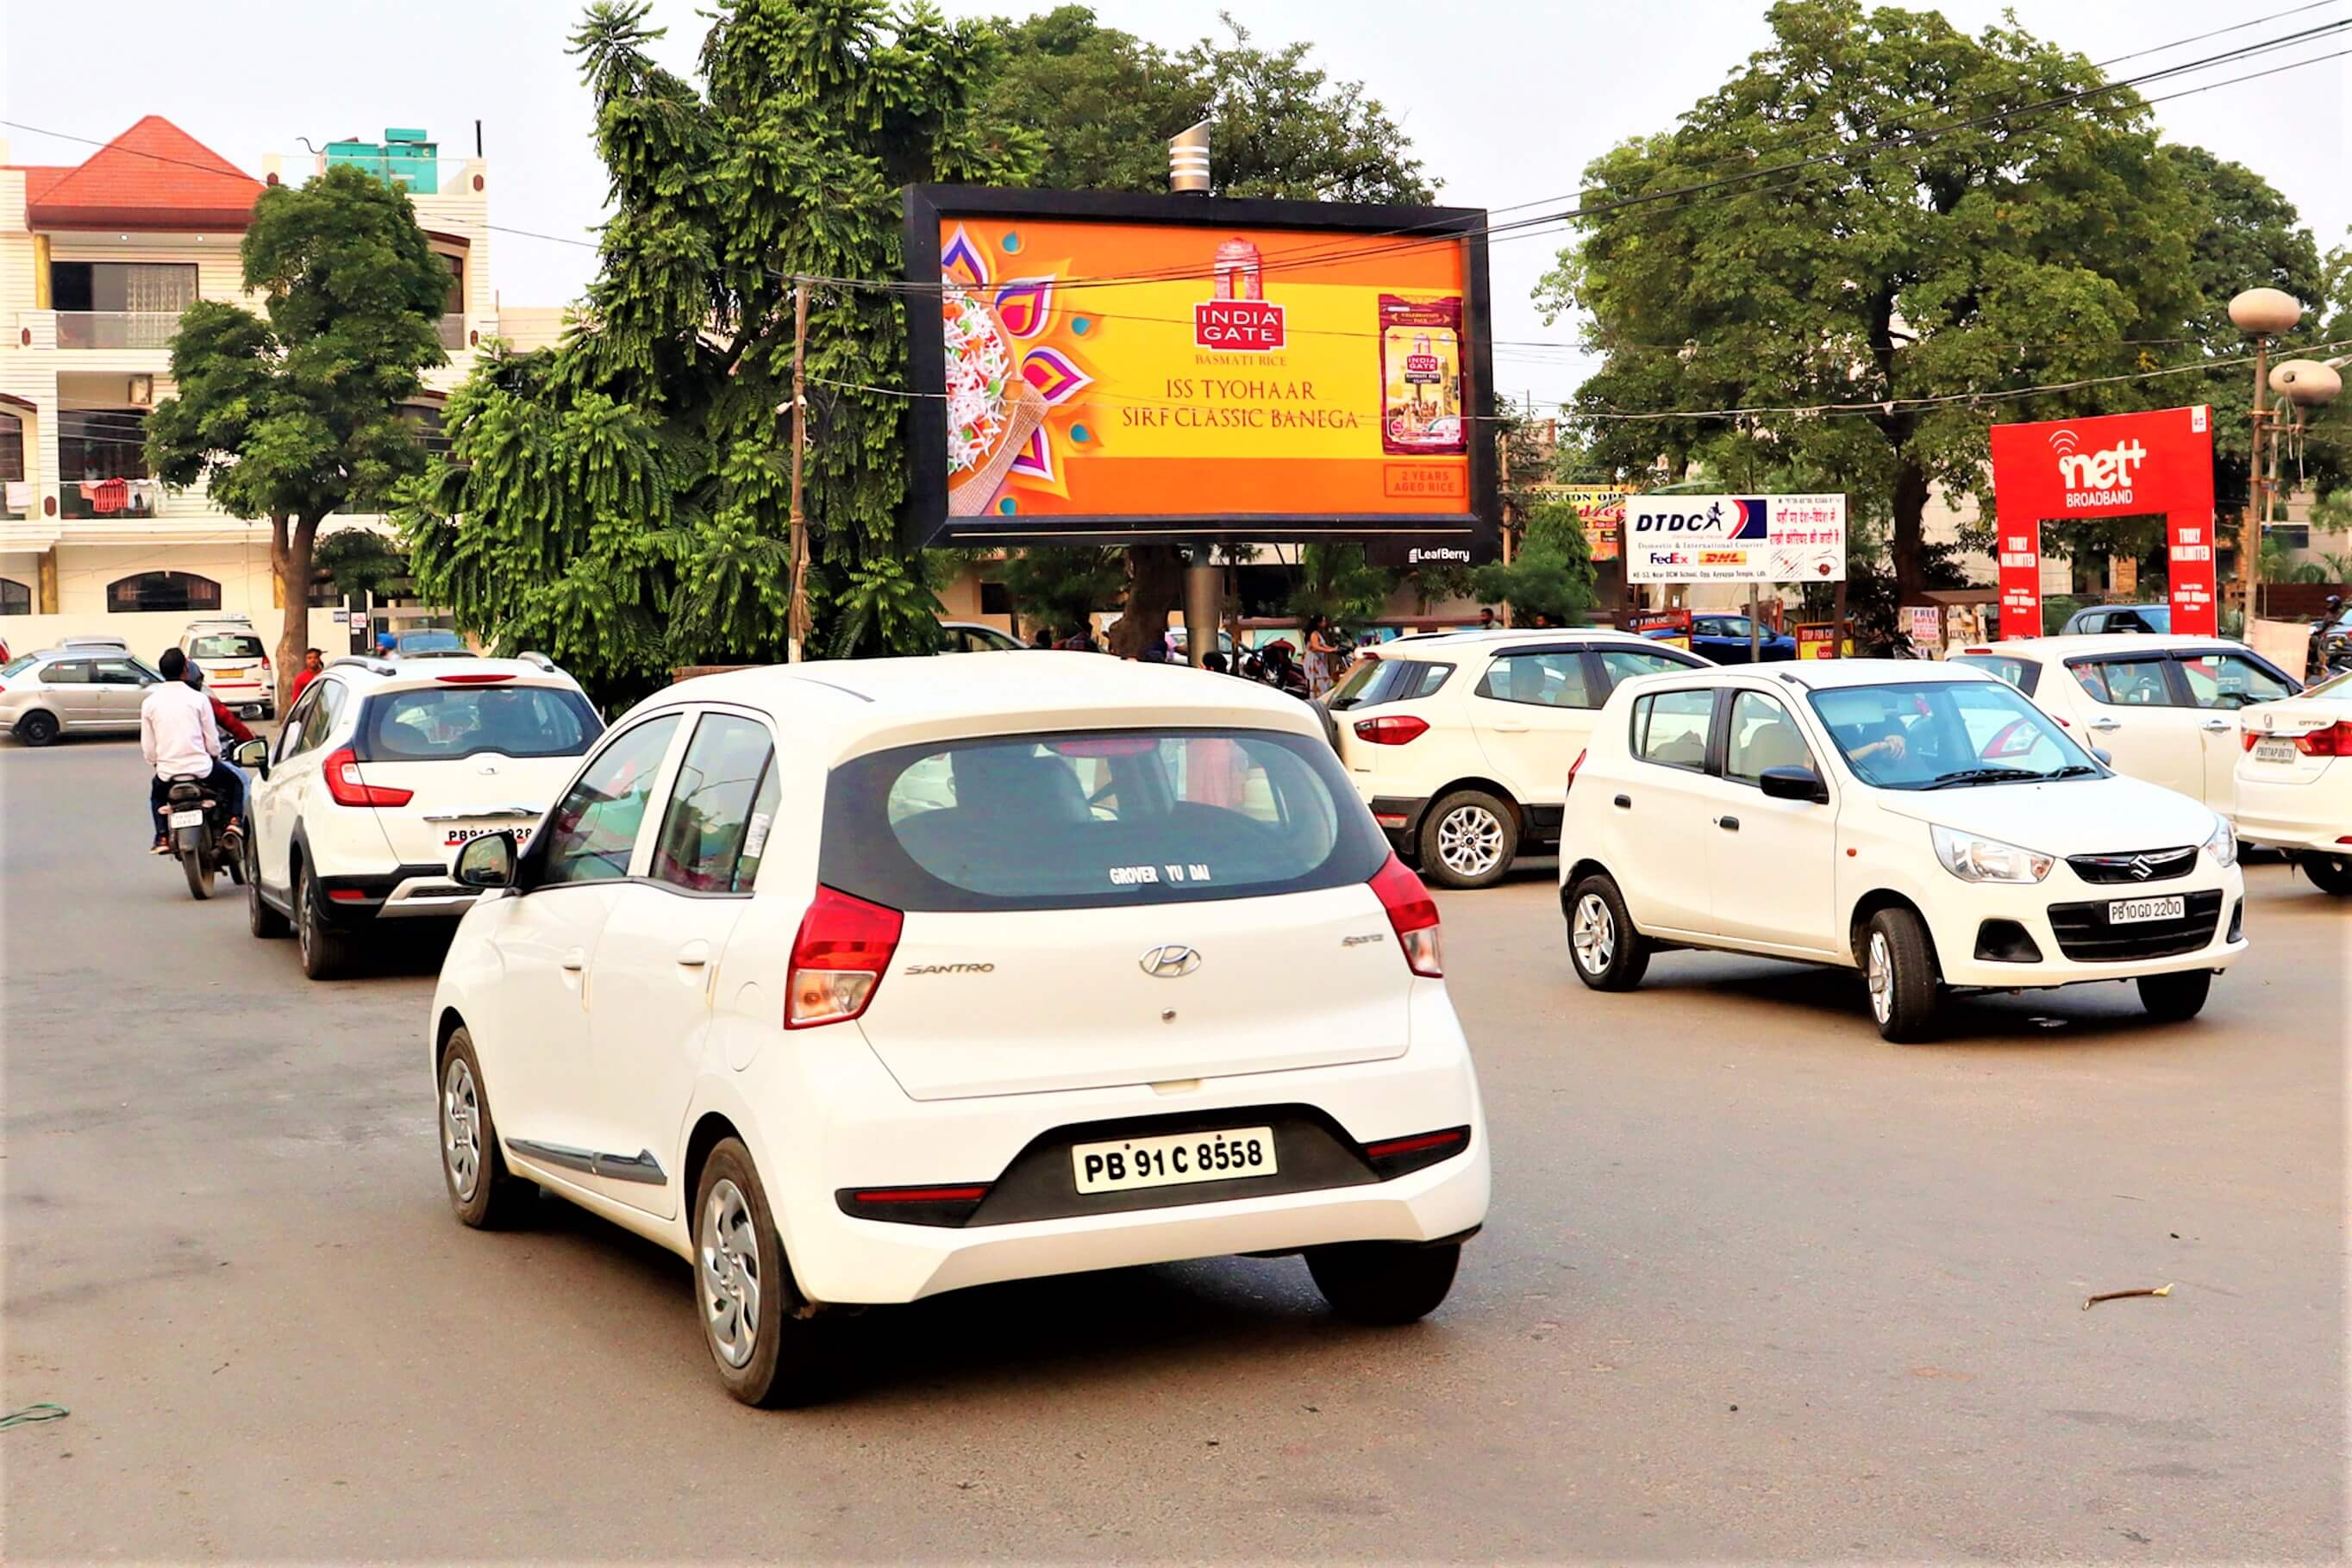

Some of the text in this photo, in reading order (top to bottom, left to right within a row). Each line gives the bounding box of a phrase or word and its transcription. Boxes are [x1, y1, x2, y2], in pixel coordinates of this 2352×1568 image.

[1202, 309, 1278, 325] INDIA
[1204, 326, 1276, 342] GATE
[1195, 354, 1287, 366] BASMATI RICE
[1167, 378, 1317, 401] ISS TYOHAAR
[1123, 407, 1360, 428] SIRF CLASSIC BANEGA
[1402, 471, 1449, 481] 2 YEARS
[1394, 482, 1455, 491] AGED RICE
[2066, 490, 2133, 508] BROADBAND
[1636, 514, 1704, 531] DTDC
[1417, 547, 1470, 563] LeafBerry
[1650, 553, 1688, 564] FedEx
[1705, 553, 1738, 563] DHL
[1110, 864, 1211, 884] GROVER YU DAI
[2154, 900, 2181, 917] 2200
[904, 963, 995, 976] SANTRO
[1085, 1139, 1262, 1183] PB 91 C 8558
